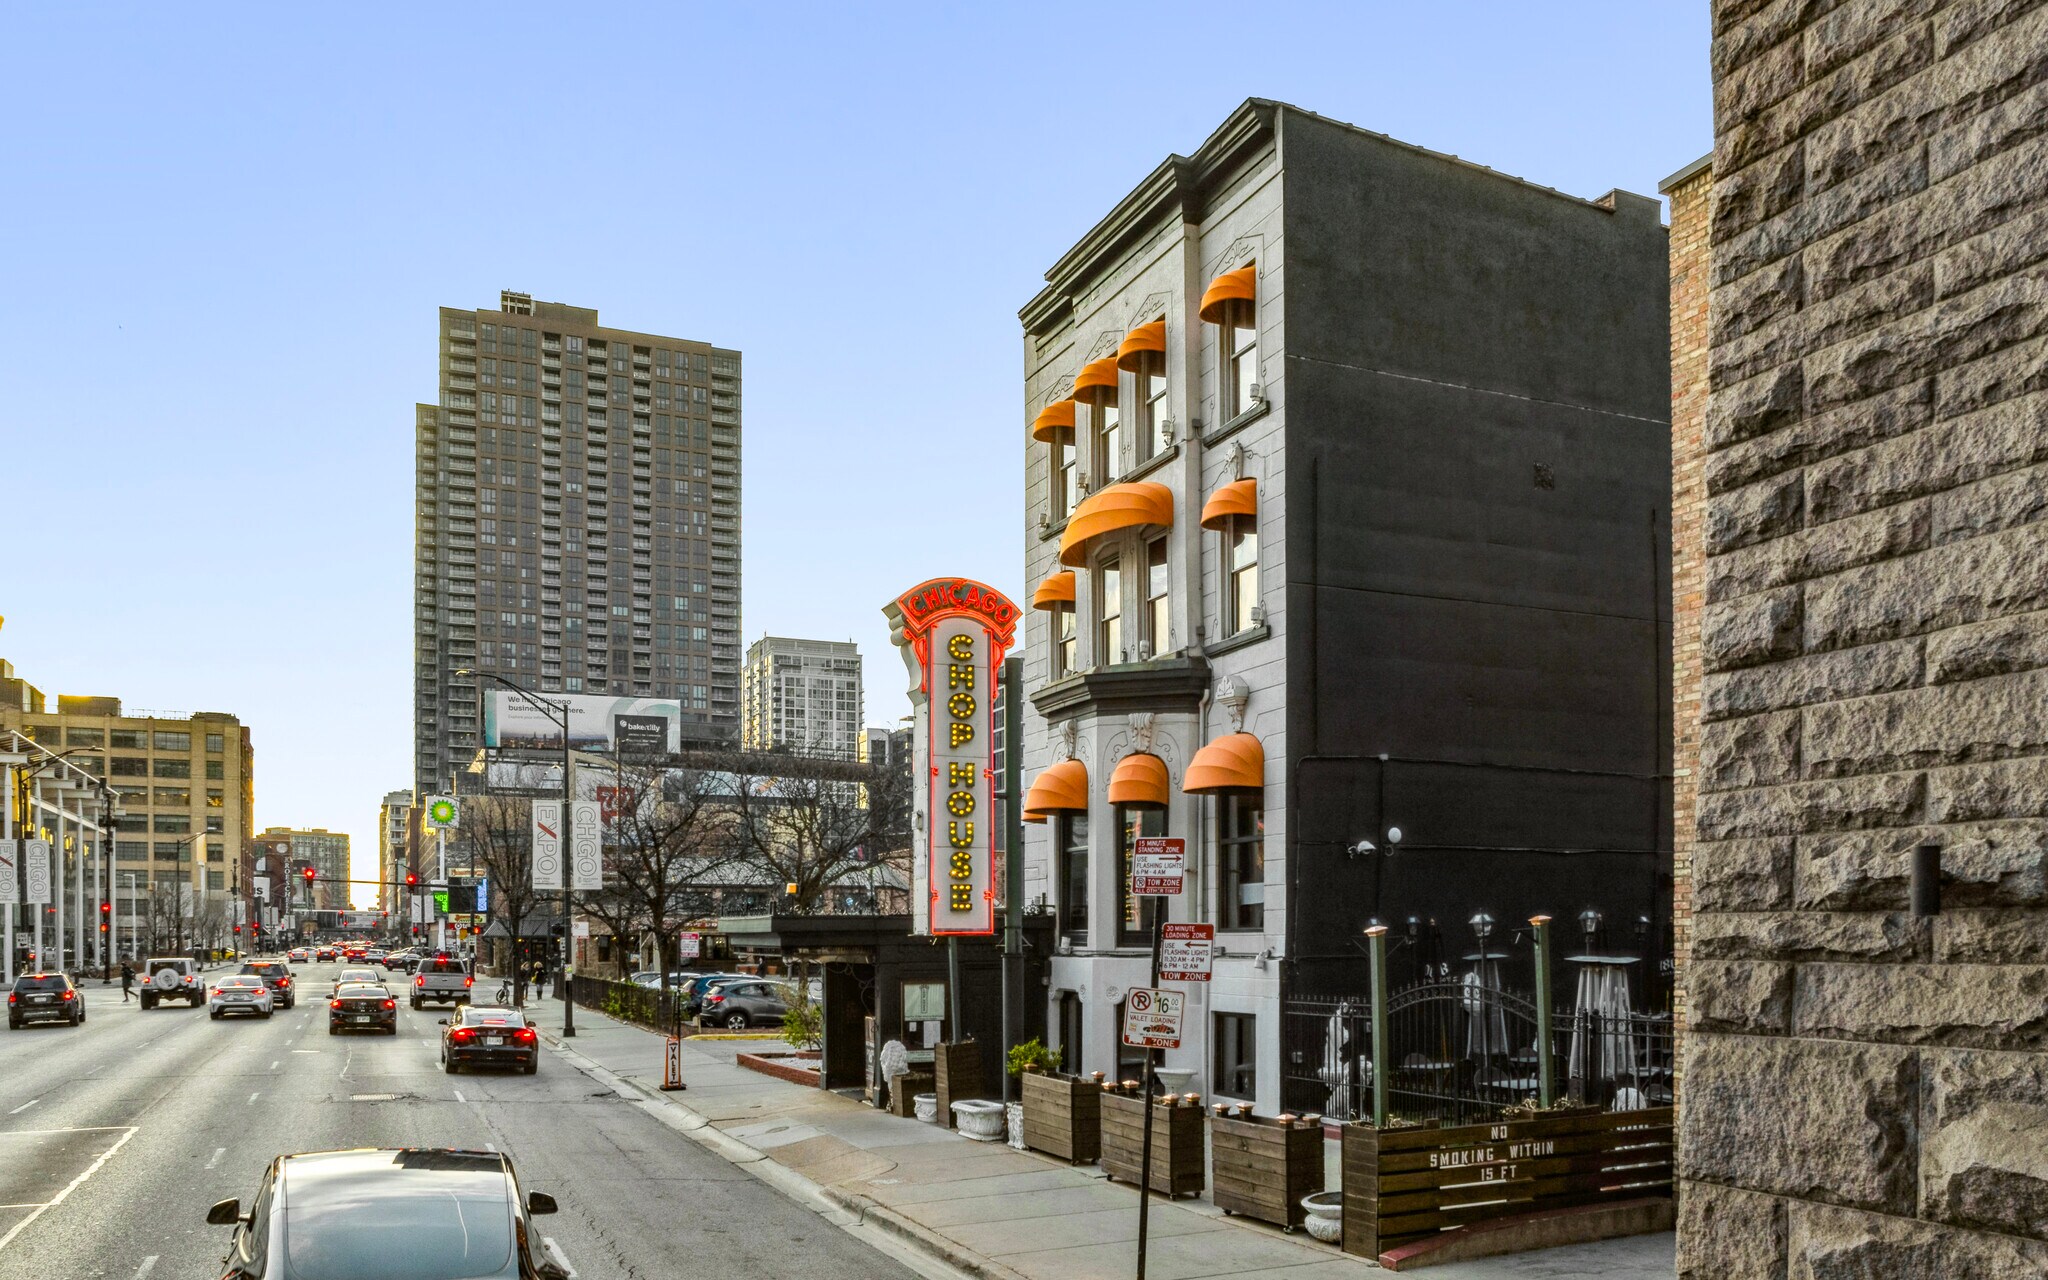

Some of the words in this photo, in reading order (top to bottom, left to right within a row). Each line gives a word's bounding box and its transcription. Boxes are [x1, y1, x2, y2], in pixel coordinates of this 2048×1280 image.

[908, 584, 1014, 623] CHICAGO
[521, 696, 539, 704] help
[540, 697, 572, 706] Chicago
[947, 634, 976, 748] CHOP
[508, 704, 551, 712] businesses
[537, 806, 558, 875] EXPO
[576, 806, 597, 877] CHGO
[946, 762, 976, 912] HOUSE
[29, 843, 47, 894] CHGO
[1164, 972, 1181, 980] TOW
[1184, 973, 1207, 981] ZONE
[1130, 1014, 1148, 1022] VALET
[1150, 1016, 1176, 1024] LOADING
[1152, 1038, 1176, 1048] ZONE
[1491, 1125, 1508, 1140] NO
[1430, 1147, 1494, 1168] SMOKING
[1509, 1141, 1554, 1159] WITHIN
[1481, 1167, 1493, 1181] 15
[1501, 1165, 1517, 1179] FT
